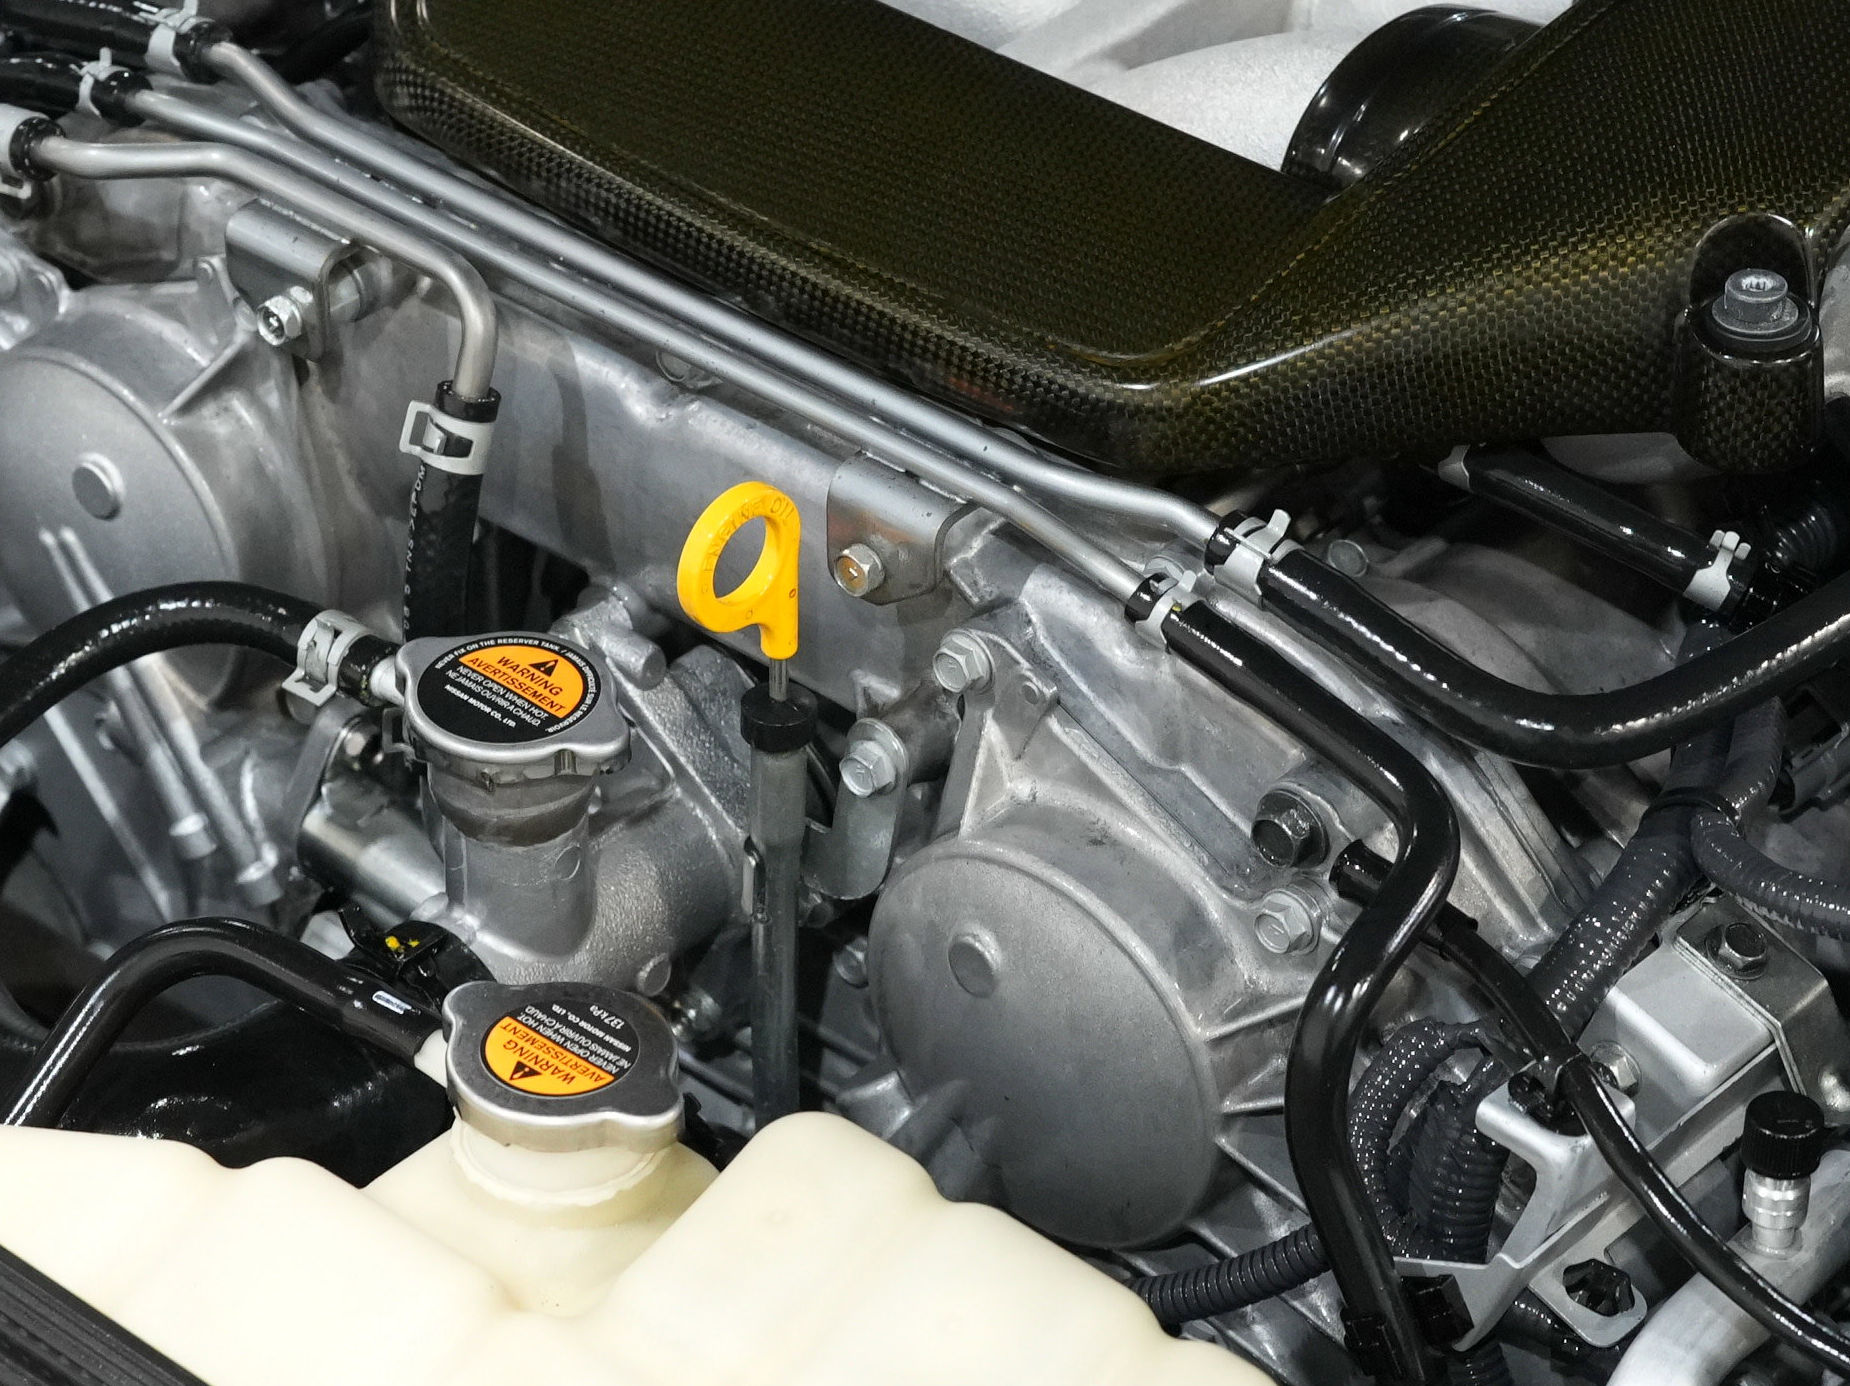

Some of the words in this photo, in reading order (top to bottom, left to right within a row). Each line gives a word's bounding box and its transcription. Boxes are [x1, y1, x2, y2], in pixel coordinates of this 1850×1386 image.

[479, 639, 496, 647] THE
[497, 638, 540, 646] RESERVER
[467, 657, 566, 712] AVERTISSEMENT
[497, 656, 563, 696] WARNING
[445, 669, 459, 680] NE
[455, 676, 483, 692] JAMAIS
[480, 689, 510, 708] OUVRIR
[457, 665, 484, 682] NEVER
[482, 679, 507, 695] OPEN
[505, 691, 531, 710] WHEN
[444, 684, 469, 701] NISSAN
[467, 697, 492, 713] MOTOR
[535, 1024, 565, 1044] WHEN
[559, 1025, 592, 1047] OUVRIR
[578, 1019, 605, 1038] MOTOR
[500, 1023, 606, 1082] AVERTISSEMENT
[563, 1040, 590, 1058] OPEN
[589, 1043, 620, 1063] JAMAIS
[603, 1034, 631, 1052] NISSAN
[503, 1039, 576, 1085] WARNING
[588, 1054, 620, 1074] NEVER
[615, 1057, 631, 1069] NE
